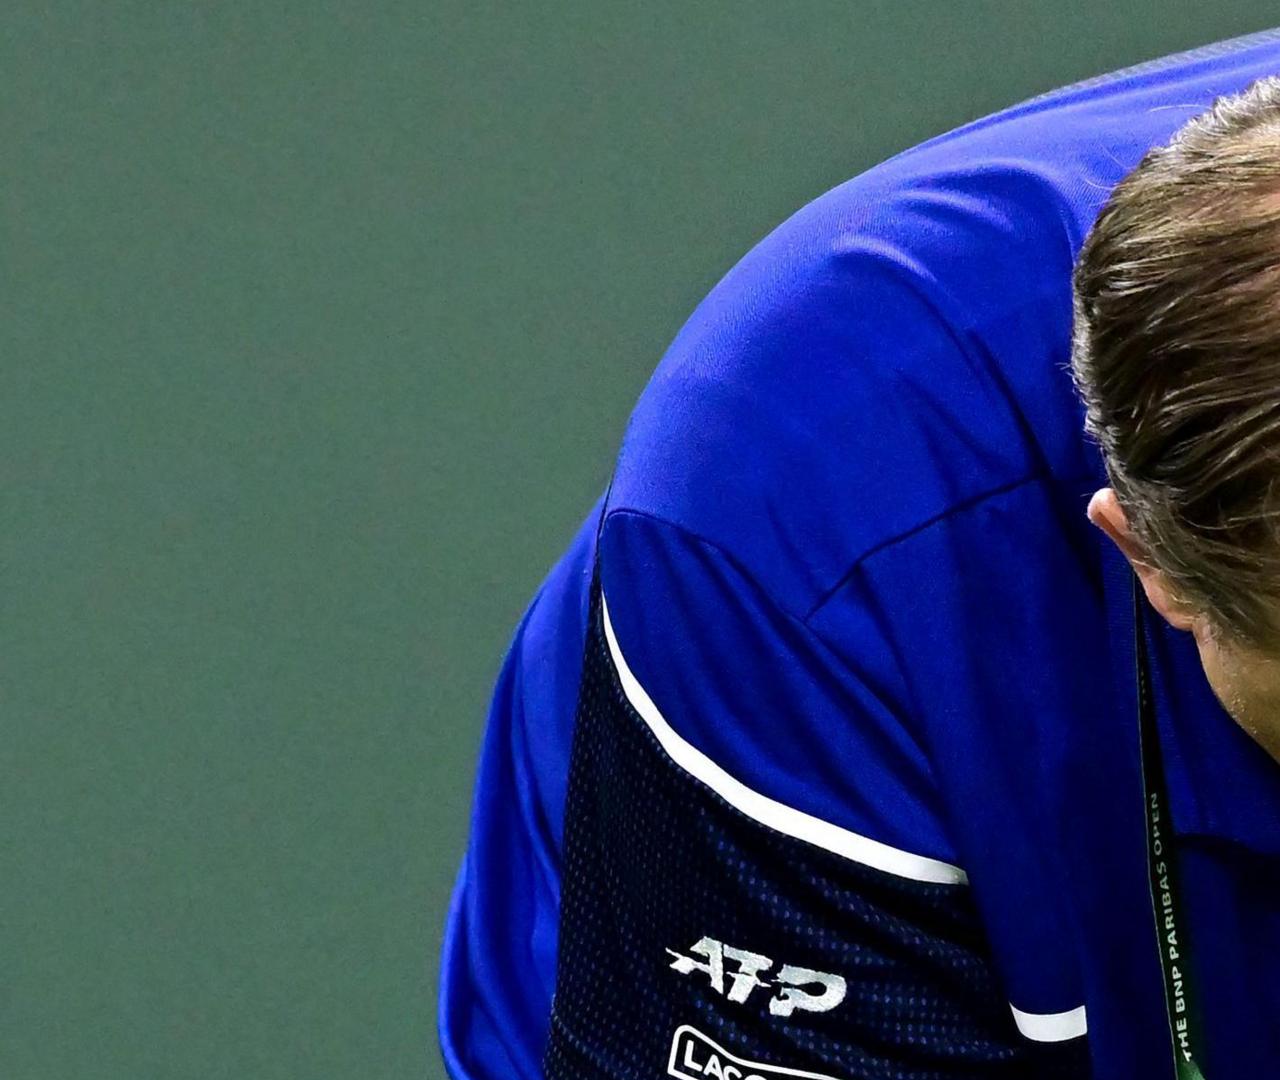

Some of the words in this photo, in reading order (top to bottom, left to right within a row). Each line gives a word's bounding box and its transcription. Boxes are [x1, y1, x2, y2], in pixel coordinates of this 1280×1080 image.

[1151, 793, 1162, 856] OPEN
[1156, 861, 1179, 960] PARIBAS
[665, 936, 847, 1017] ATP
[1172, 966, 1186, 1013] BNP
[1176, 1017, 1192, 1062] THE
